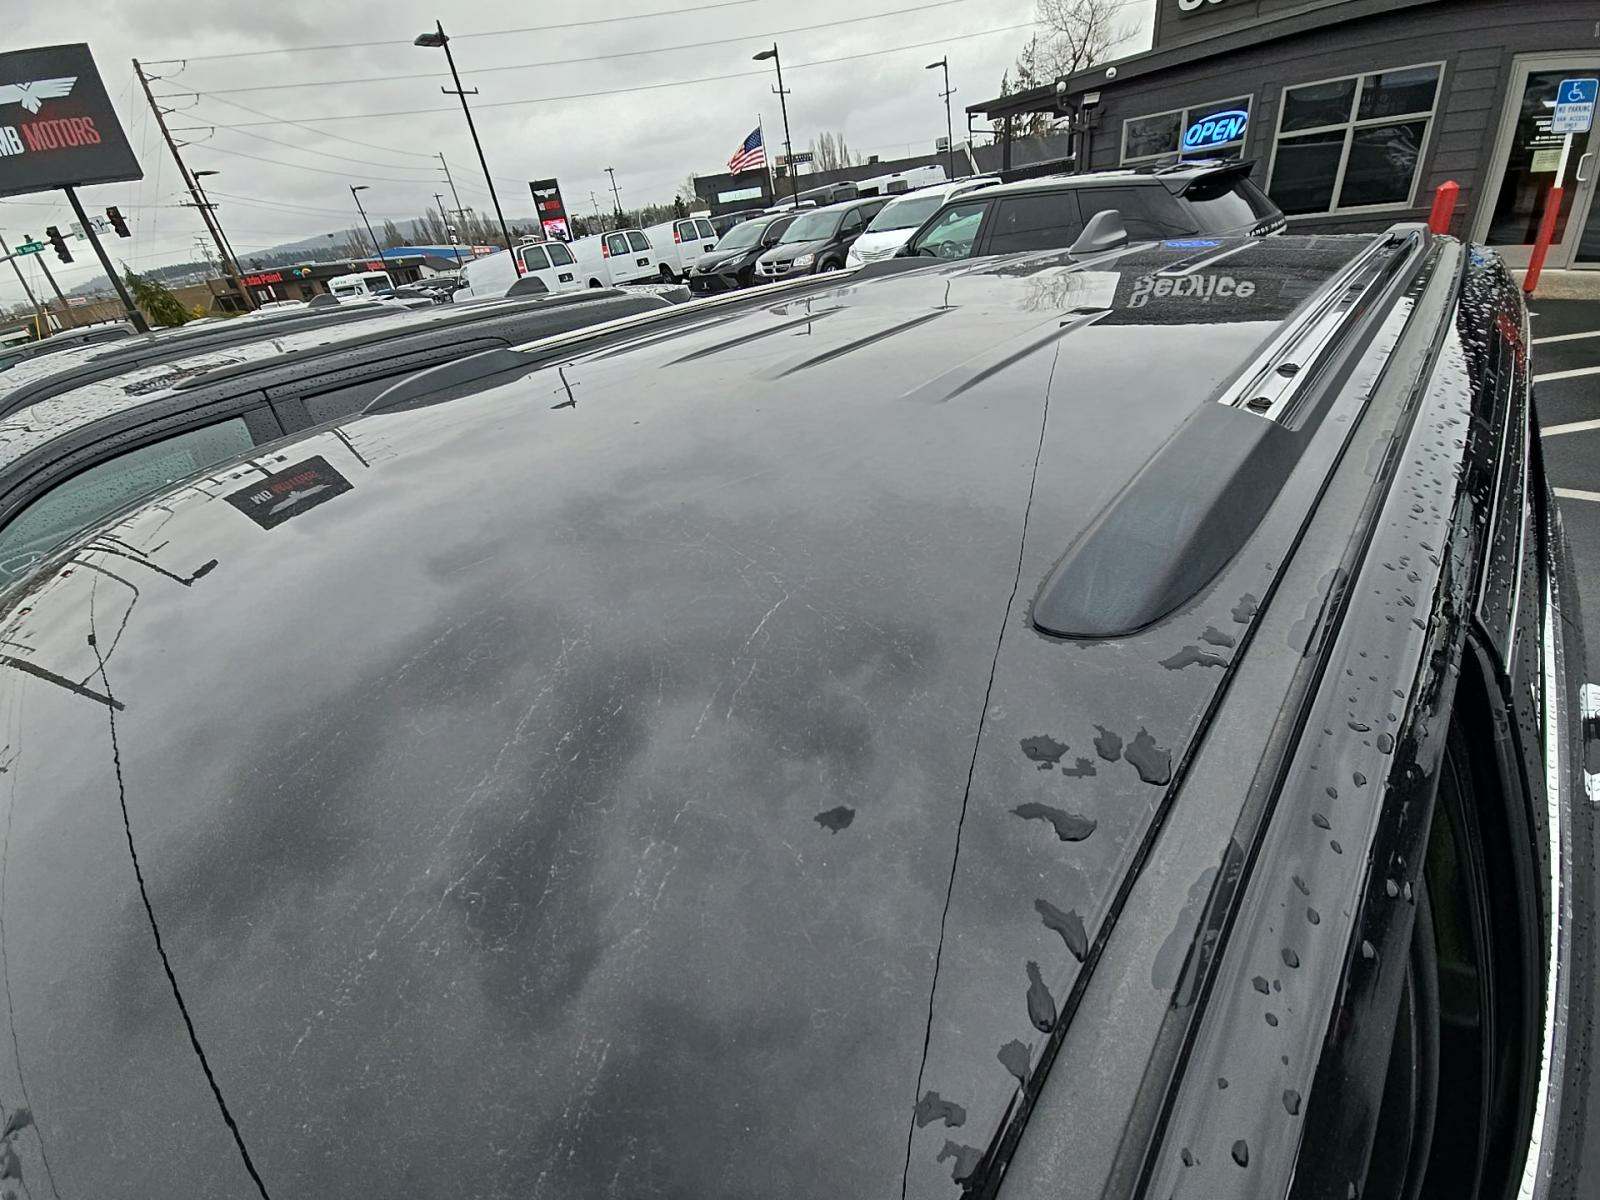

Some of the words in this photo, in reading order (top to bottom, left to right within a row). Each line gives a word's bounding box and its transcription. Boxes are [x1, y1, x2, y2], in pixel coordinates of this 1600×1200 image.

[0, 126, 25, 157] MB
[21, 116, 101, 151] MOTORS
[1185, 117, 1243, 144] OPEN
[1245, 225, 1270, 238] RANGE
